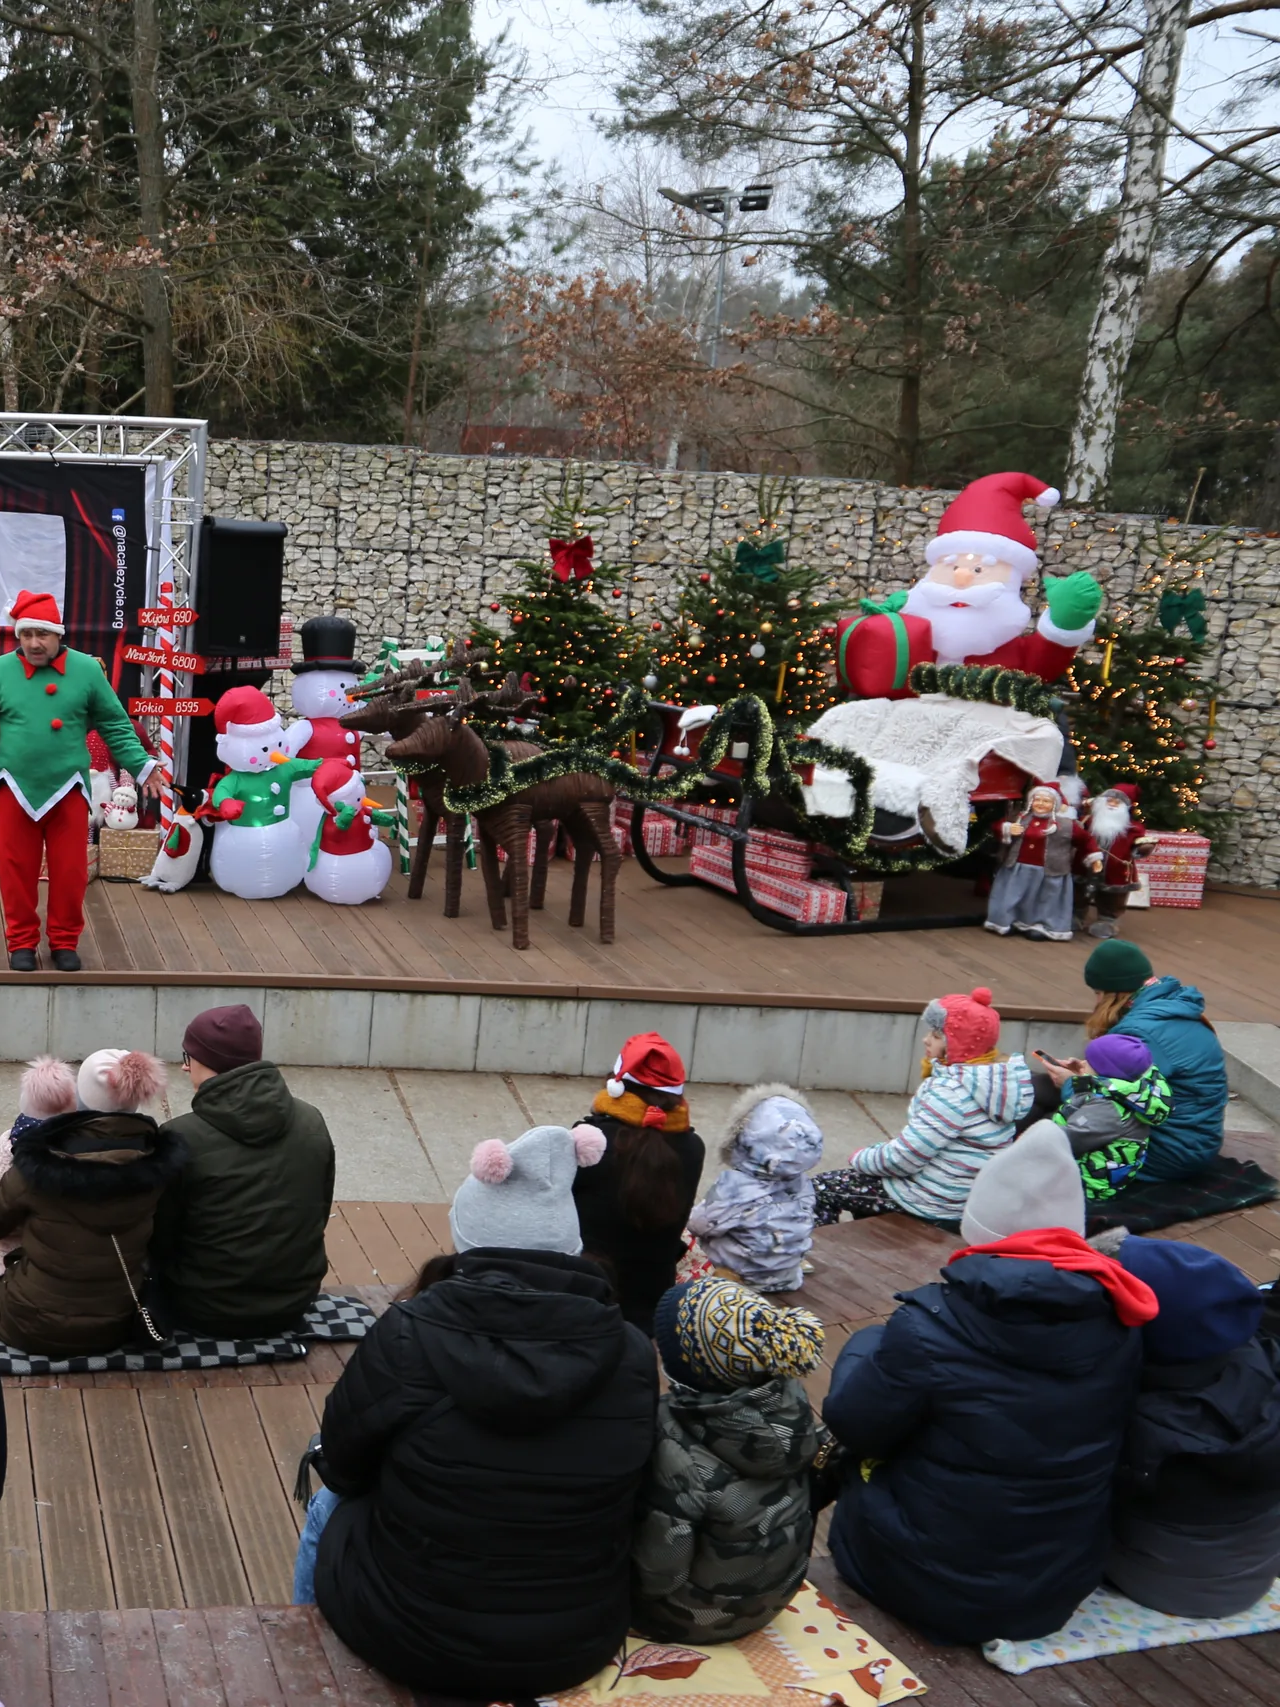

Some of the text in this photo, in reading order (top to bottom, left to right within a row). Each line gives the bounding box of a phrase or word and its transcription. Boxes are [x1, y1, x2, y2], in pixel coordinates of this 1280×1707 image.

[112, 524, 127, 629] @nacalezycie.org
[173, 610, 192, 623] 690
[125, 647, 197, 670] New York 6800
[134, 701, 199, 713] Tokio 8595
